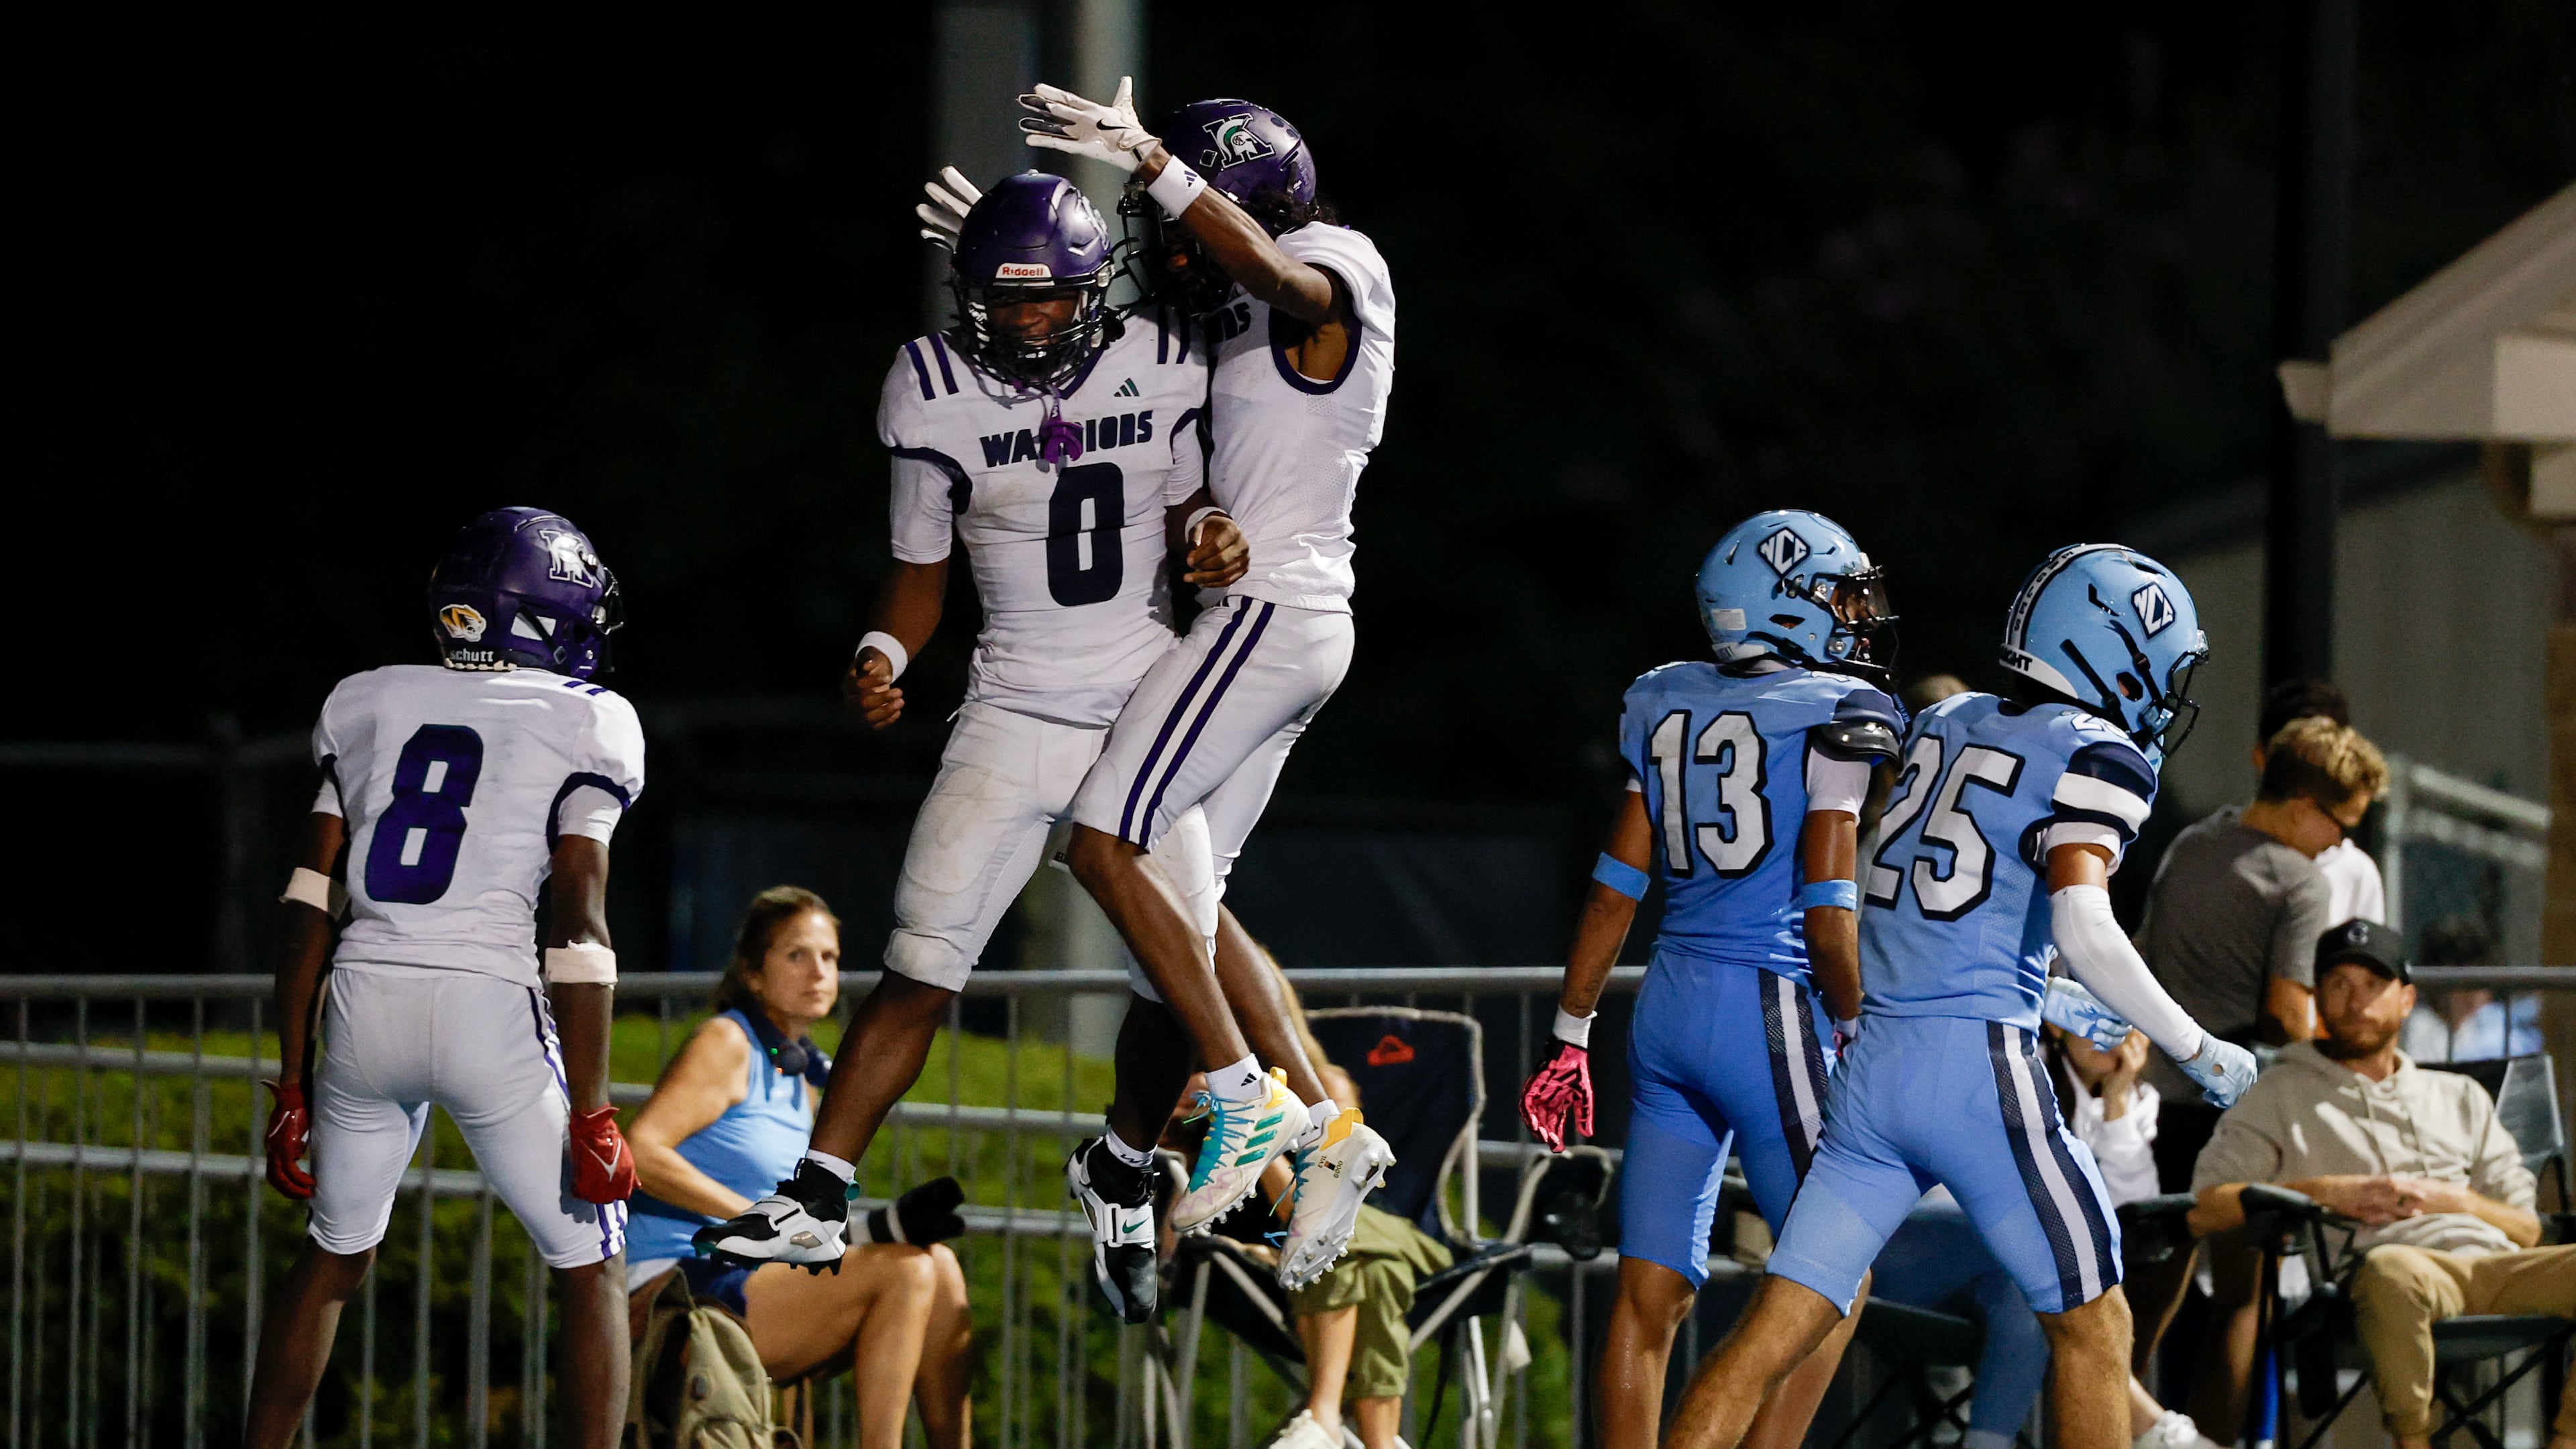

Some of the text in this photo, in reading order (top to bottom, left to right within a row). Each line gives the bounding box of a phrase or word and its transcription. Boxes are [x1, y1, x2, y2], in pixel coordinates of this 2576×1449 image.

[1002, 266, 1043, 276] Riddell
[979, 411, 1153, 468] WAIORS
[1046, 462, 1124, 606] 0
[449, 648, 494, 662] schutt
[364, 723, 484, 905] 8
[1651, 710, 1771, 879] 13
[1864, 734, 2025, 921] 25
[1318, 1155, 1327, 1169] EVIL
[1333, 1160, 1344, 1179] GOOD
